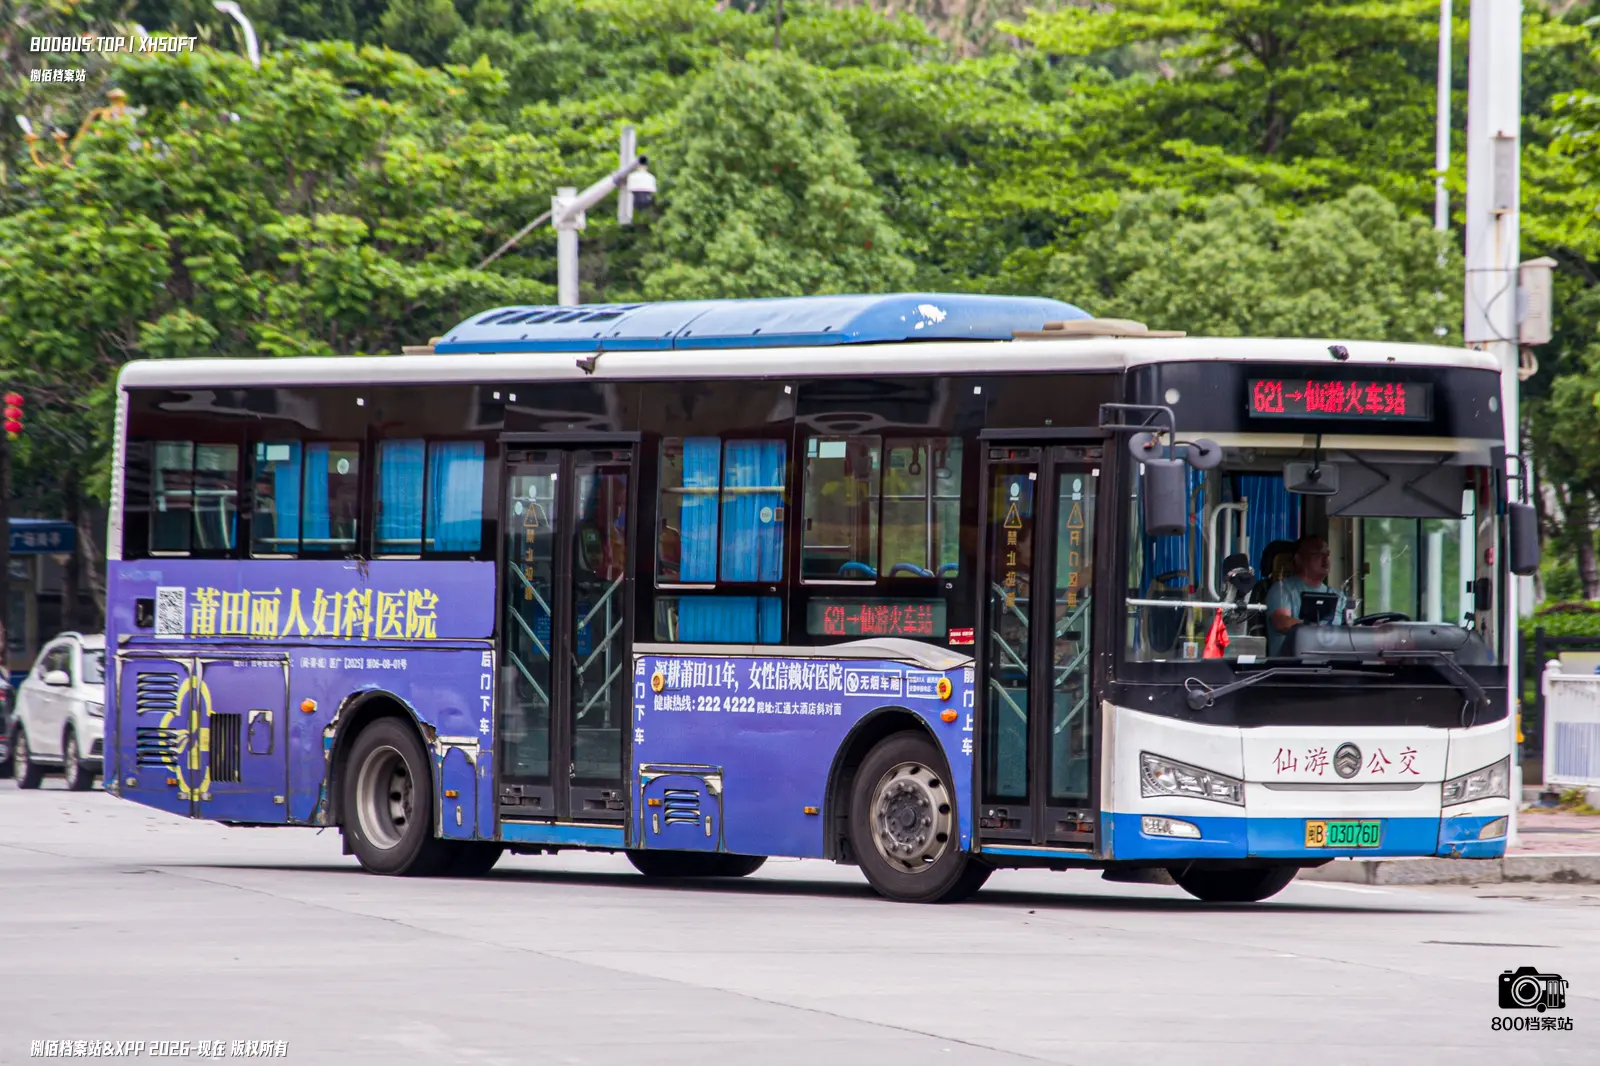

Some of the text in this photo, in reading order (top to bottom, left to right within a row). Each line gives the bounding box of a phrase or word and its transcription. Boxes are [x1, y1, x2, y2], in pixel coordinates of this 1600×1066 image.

[1253, 380, 1406, 415] 621 仙游火车站
[190, 587, 439, 641] 莆田丽人妇科医院
[824, 604, 933, 636] 621 仙游火车站
[480, 651, 492, 735] 后门下车
[860, 675, 900, 691] 无烟车厢
[635, 658, 647, 745] 后门下车
[697, 696, 721, 712] 222
[723, 697, 756, 713] 4222
[1272, 746, 1420, 776] 仙游 公交
